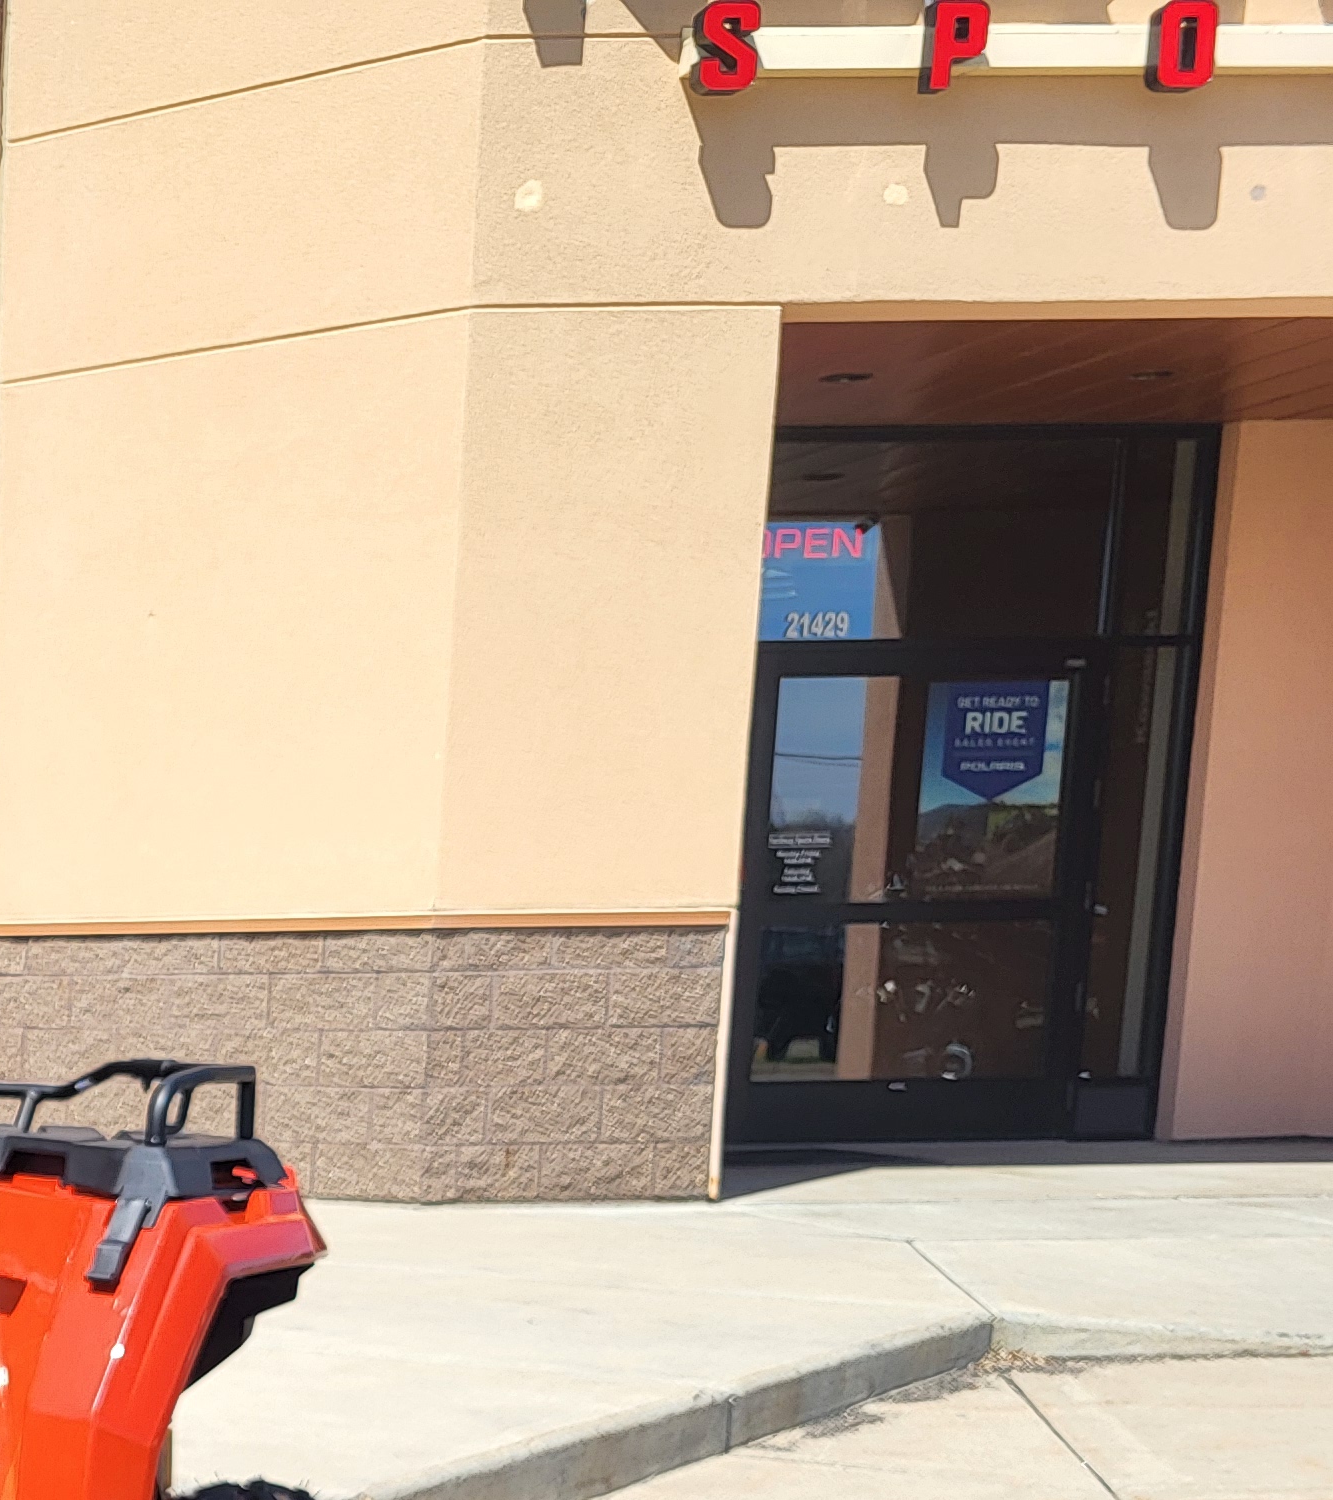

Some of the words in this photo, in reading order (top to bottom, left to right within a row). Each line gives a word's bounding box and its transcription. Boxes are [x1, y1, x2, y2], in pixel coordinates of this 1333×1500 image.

[784, 610, 850, 639] 21429
[957, 696, 981, 709] GET
[982, 695, 1021, 709] READY
[1025, 695, 1040, 707] TO
[965, 711, 1028, 735] RIDE
